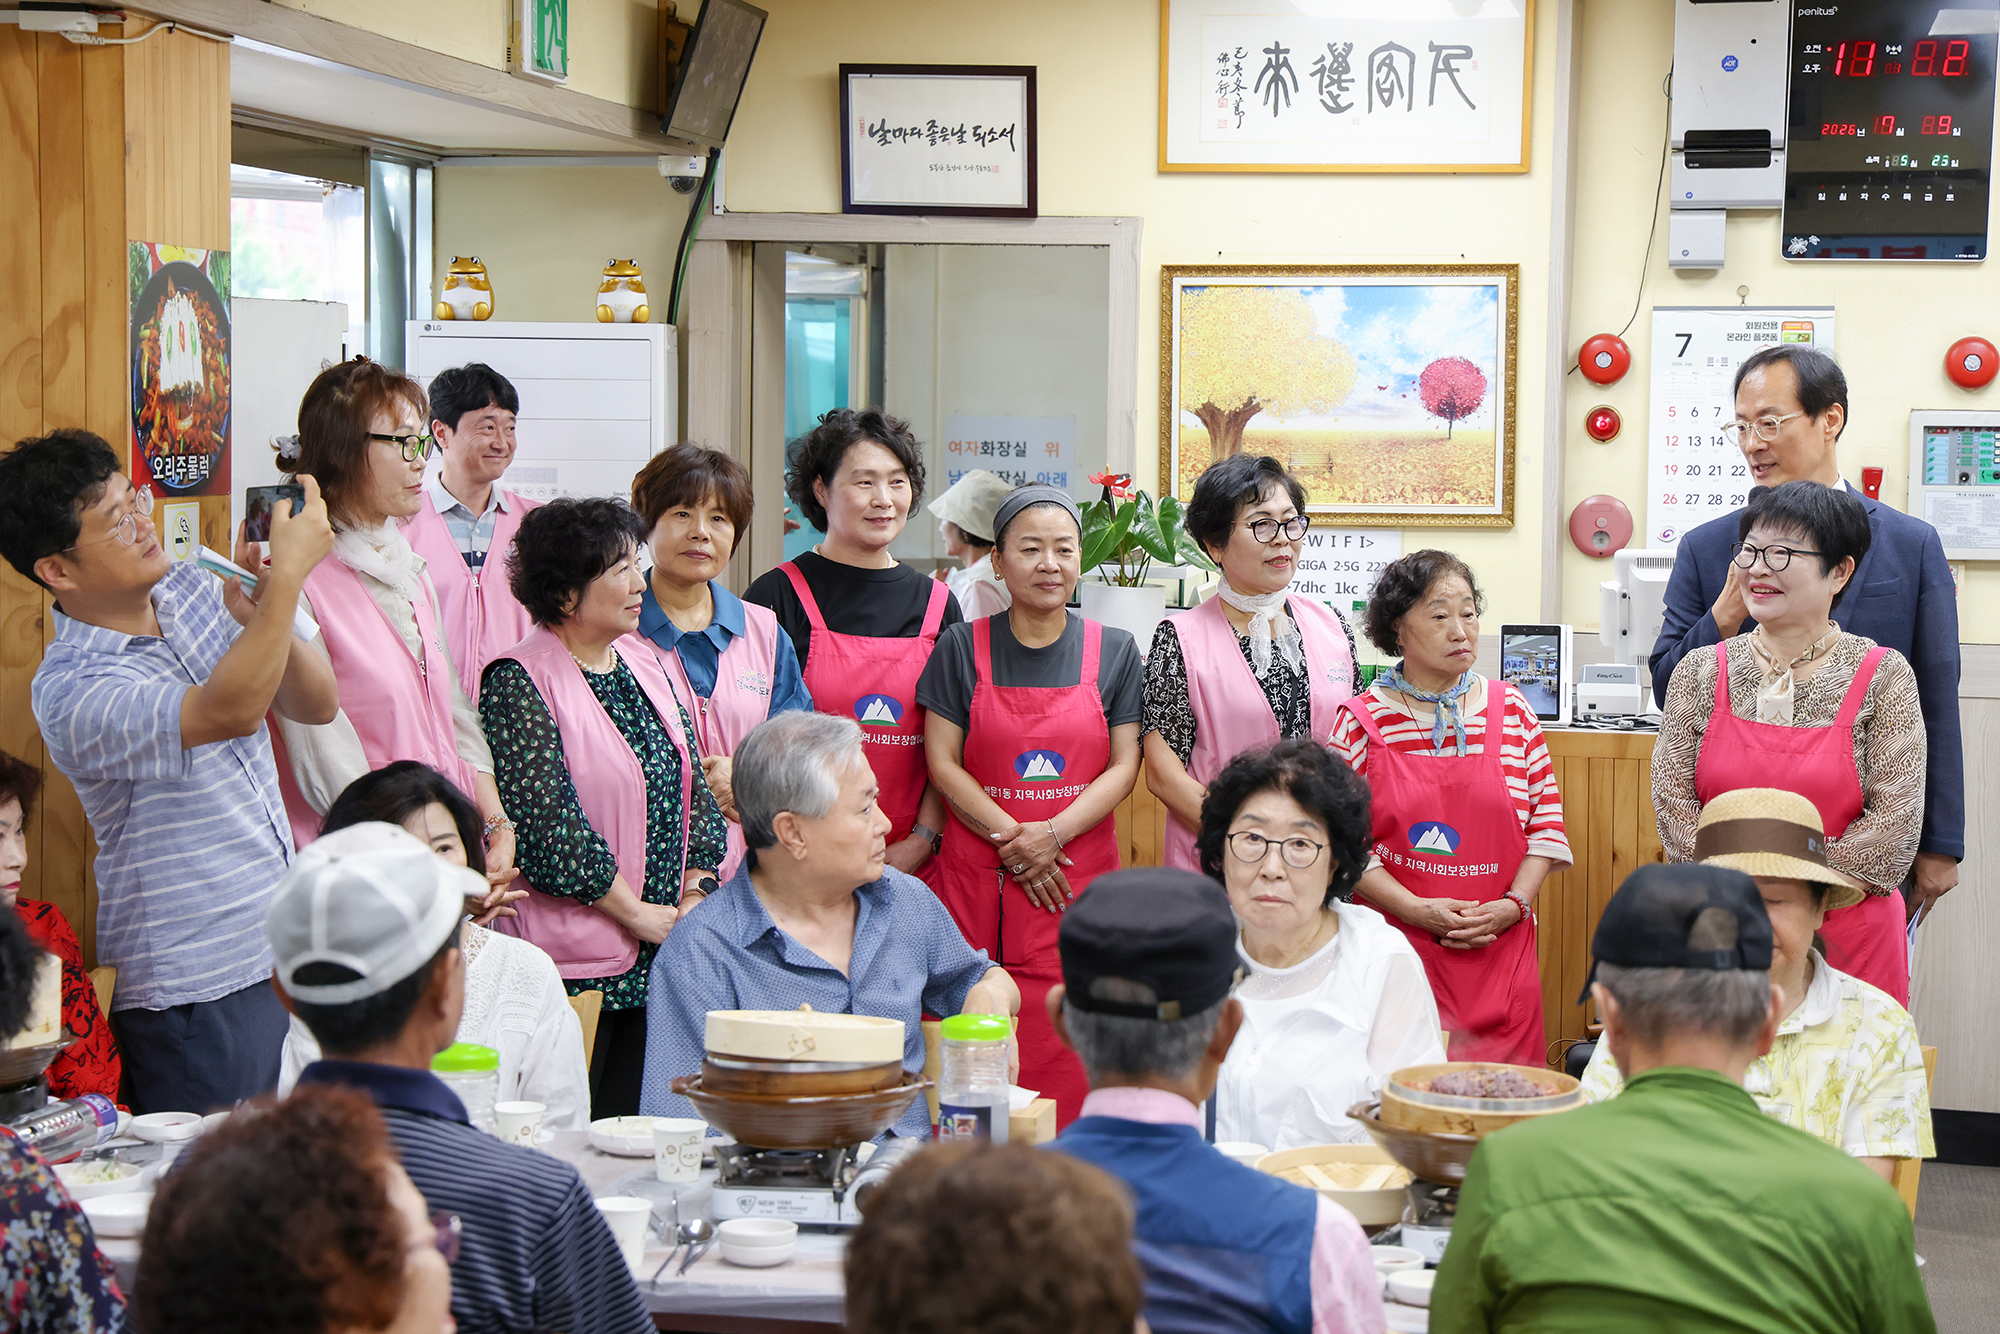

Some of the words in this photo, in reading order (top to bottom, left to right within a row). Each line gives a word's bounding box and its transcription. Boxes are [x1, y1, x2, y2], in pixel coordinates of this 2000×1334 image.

[1798, 8, 1835, 17] penitus
[868, 118, 923, 146] 날마다
[972, 123, 1015, 152] 되소서
[1745, 321, 1778, 330] 회원전용
[1726, 333, 1751, 342] 온라인
[1753, 333, 1778, 342] 플랫폼
[1675, 333, 1693, 358] 7
[1668, 406, 1676, 418] 5
[1691, 406, 1699, 418] 6
[1714, 406, 1721, 418] 7
[1665, 435, 1679, 446] 12
[1688, 436, 1701, 447] 13
[1710, 436, 1724, 447] 14
[948, 440, 1027, 457] 여자화장실
[1045, 441, 1059, 458] 위
[153, 454, 209, 480] 오리주물럭
[1664, 464, 1678, 475] 19
[1686, 464, 1701, 476] 20
[1708, 465, 1721, 476] 21
[1731, 465, 1746, 476] 22
[1663, 493, 1678, 505] 26
[1685, 493, 1700, 505] 27
[1707, 494, 1723, 505] 28
[1730, 494, 1745, 505] 29
[1297, 560, 1327, 571] GIGA
[1375, 843, 1403, 865] 쌍문1동
[1405, 857, 1499, 877] 지역사회보장협의체
